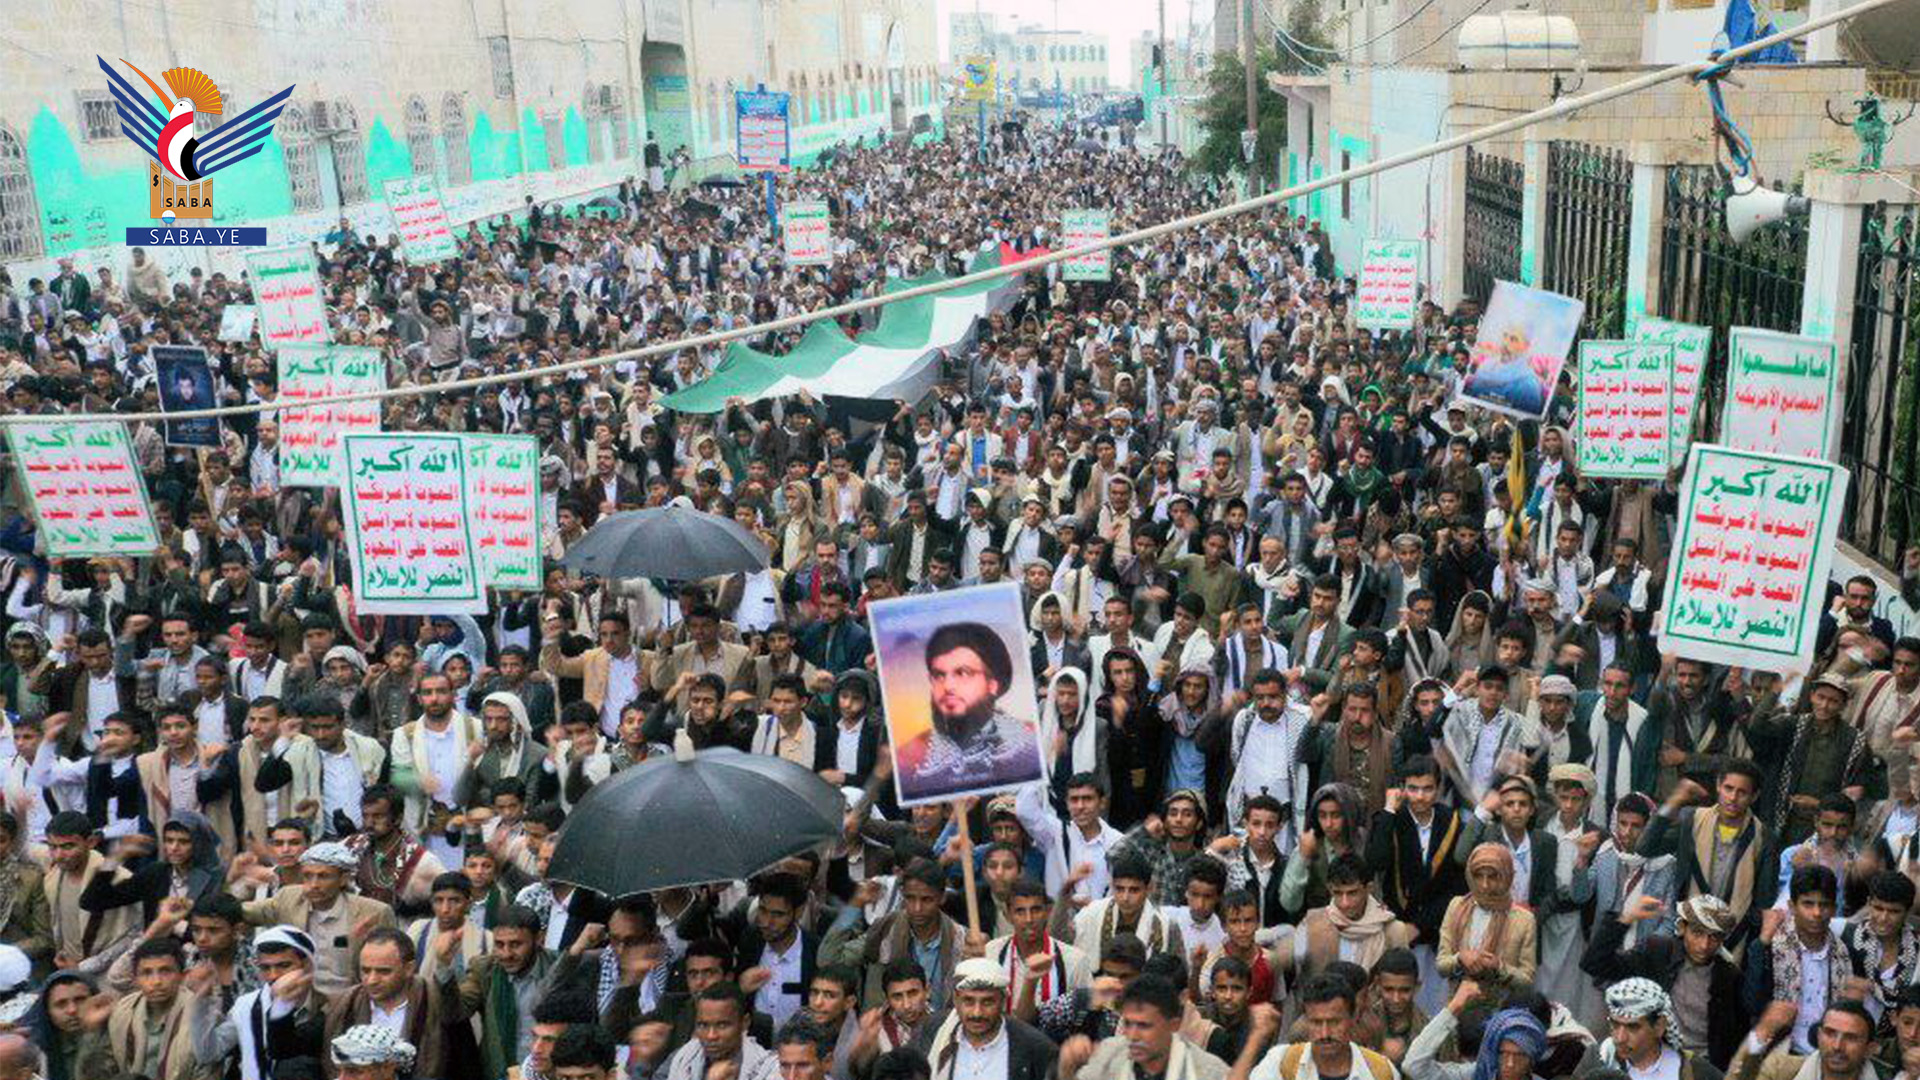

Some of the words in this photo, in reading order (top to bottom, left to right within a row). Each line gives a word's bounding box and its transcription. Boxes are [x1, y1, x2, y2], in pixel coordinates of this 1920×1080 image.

[420, 446, 458, 473] الله
[416, 484, 459, 505] الموت
[1774, 473, 1824, 505] الله
[419, 514, 462, 534] الموت
[1761, 521, 1815, 541] الموت
[364, 540, 402, 561] اليهود
[406, 541, 427, 560] على
[432, 541, 466, 559] اللعنة
[1755, 552, 1809, 572] الموت
[424, 563, 469, 594] النصر
[1681, 567, 1728, 594] اليهود
[1730, 576, 1757, 600] على
[1761, 581, 1802, 604] اللعنة
[1739, 608, 1796, 640] النصر
